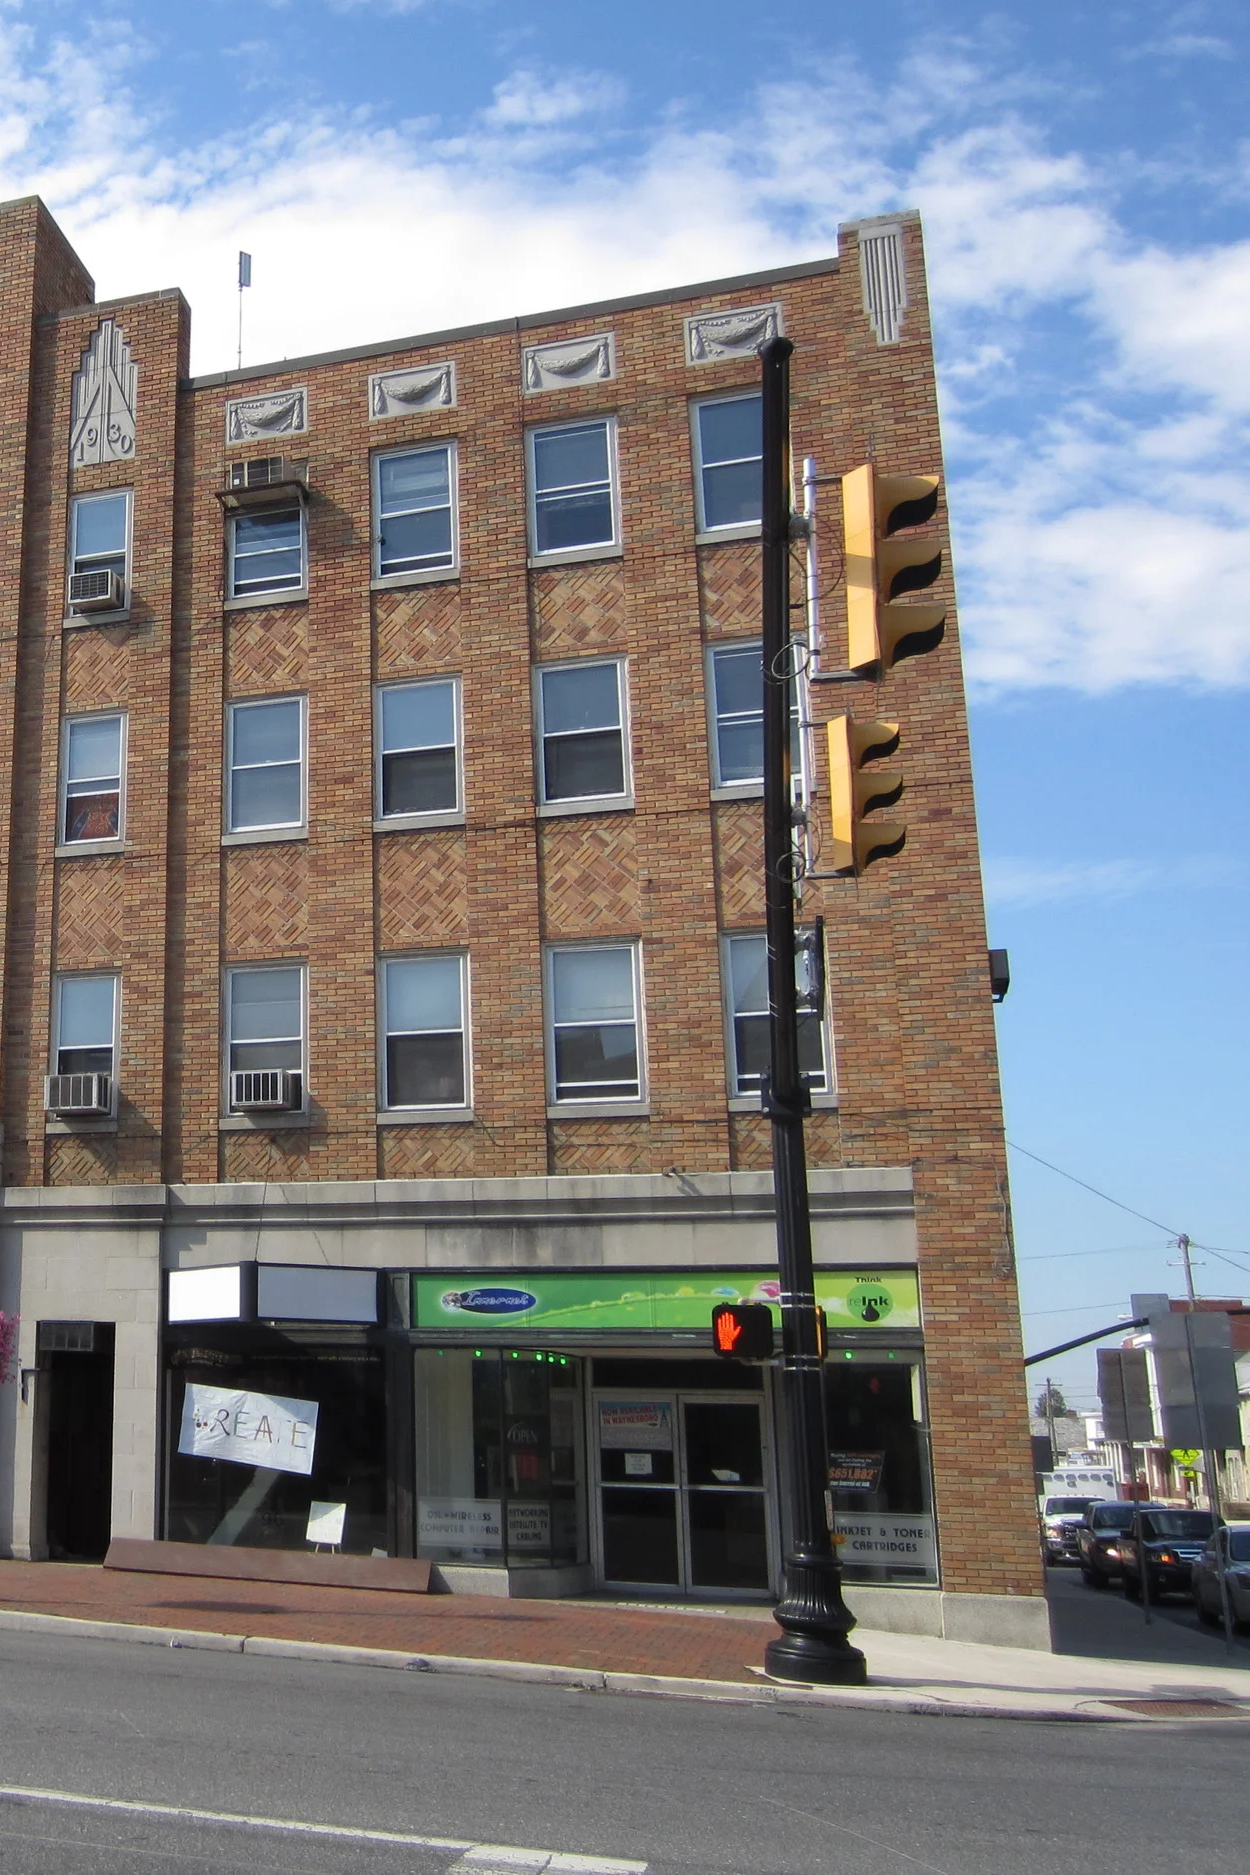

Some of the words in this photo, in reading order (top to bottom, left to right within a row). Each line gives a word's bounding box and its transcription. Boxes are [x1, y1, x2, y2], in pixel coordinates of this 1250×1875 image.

[854, 1276, 883, 1284] Think
[512, 1429, 538, 1443] OPEN
[427, 1510, 443, 1520] DSL
[450, 1510, 491, 1522] WIRELESS
[508, 1507, 549, 1518] NETWORKING
[420, 1523, 465, 1534] COMPUTER
[469, 1524, 500, 1535] REPAIR
[836, 1526, 872, 1537] INKJET
[880, 1527, 887, 1538] &
[893, 1528, 931, 1539] TONER
[516, 1531, 542, 1541] CABLING
[852, 1540, 918, 1553] CARTRIDGES
